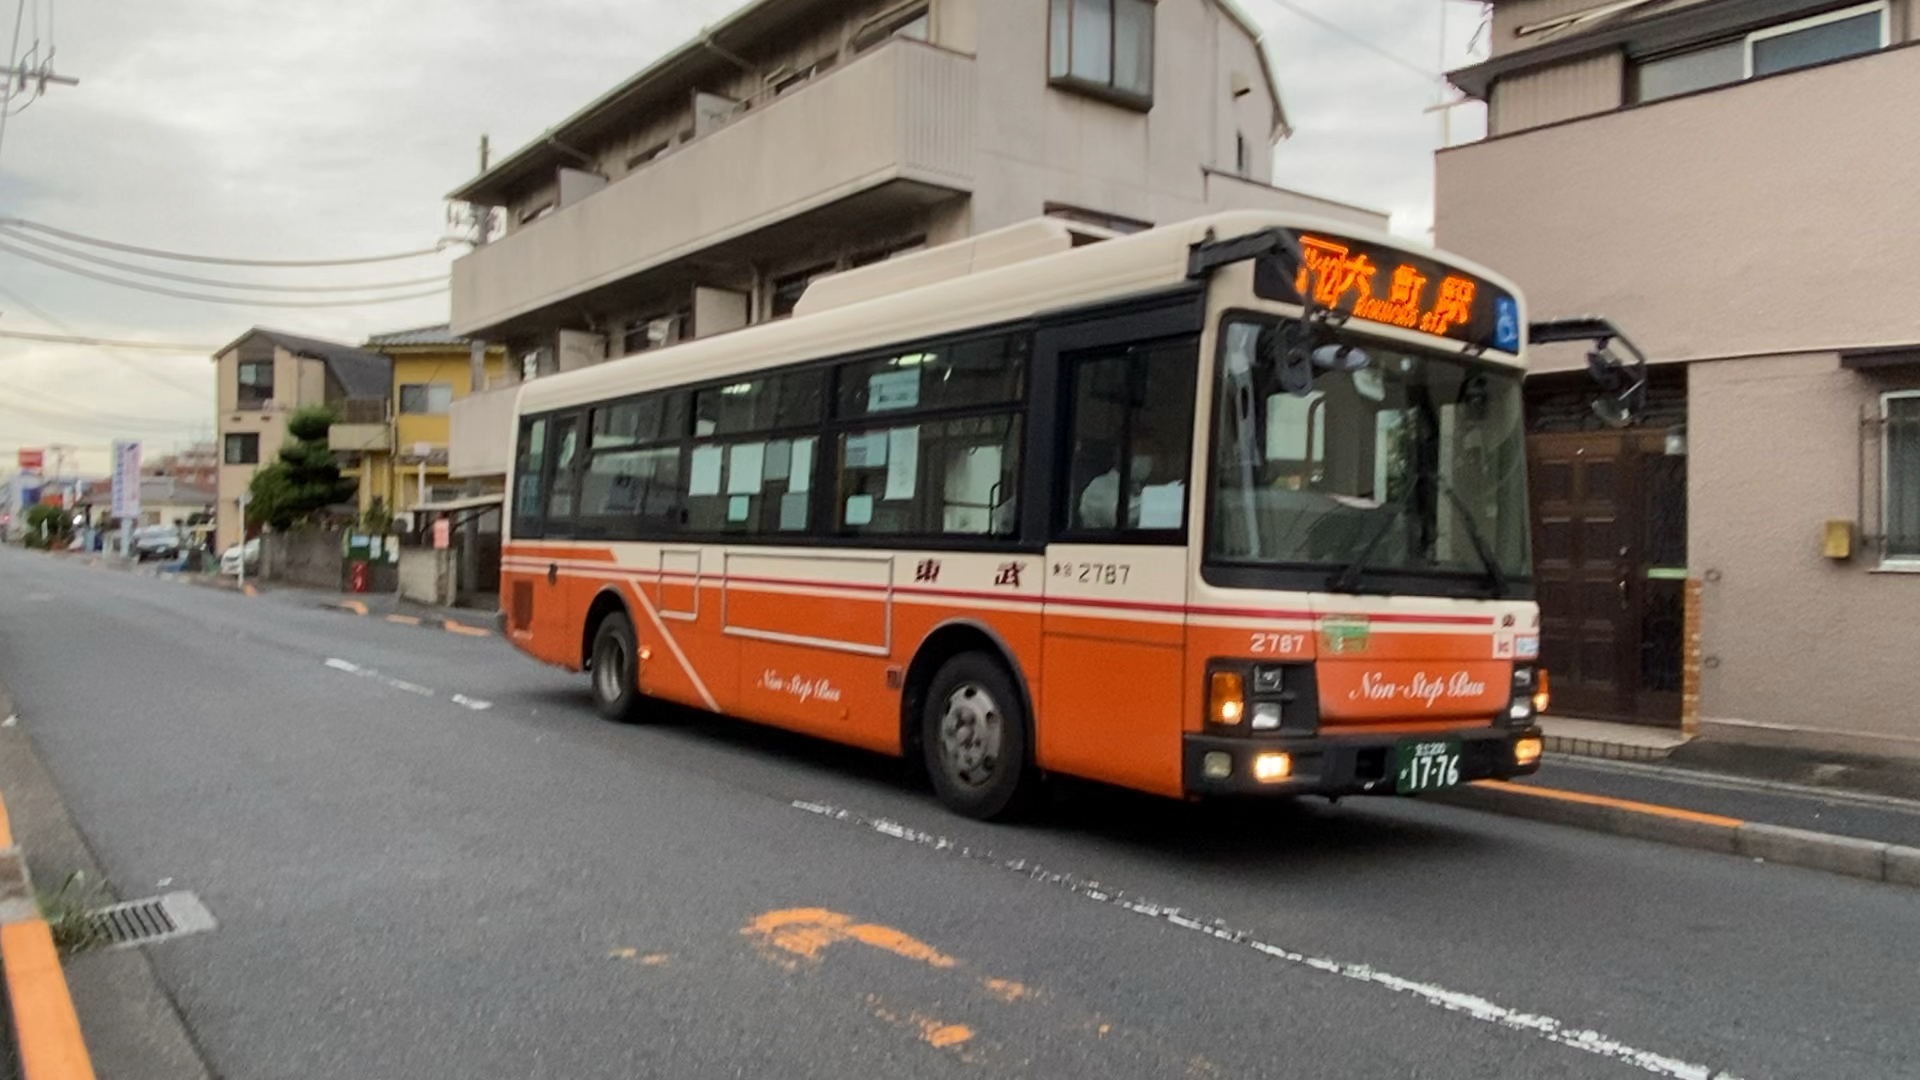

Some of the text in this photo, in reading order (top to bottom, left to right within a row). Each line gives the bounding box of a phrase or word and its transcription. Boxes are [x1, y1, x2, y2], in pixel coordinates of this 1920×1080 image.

[1077, 561, 1132, 586] 2787
[1249, 632, 1304, 654] 2787
[757, 667, 841, 704] Non-Step Bus
[1348, 671, 1485, 709] Non-Step Bus
